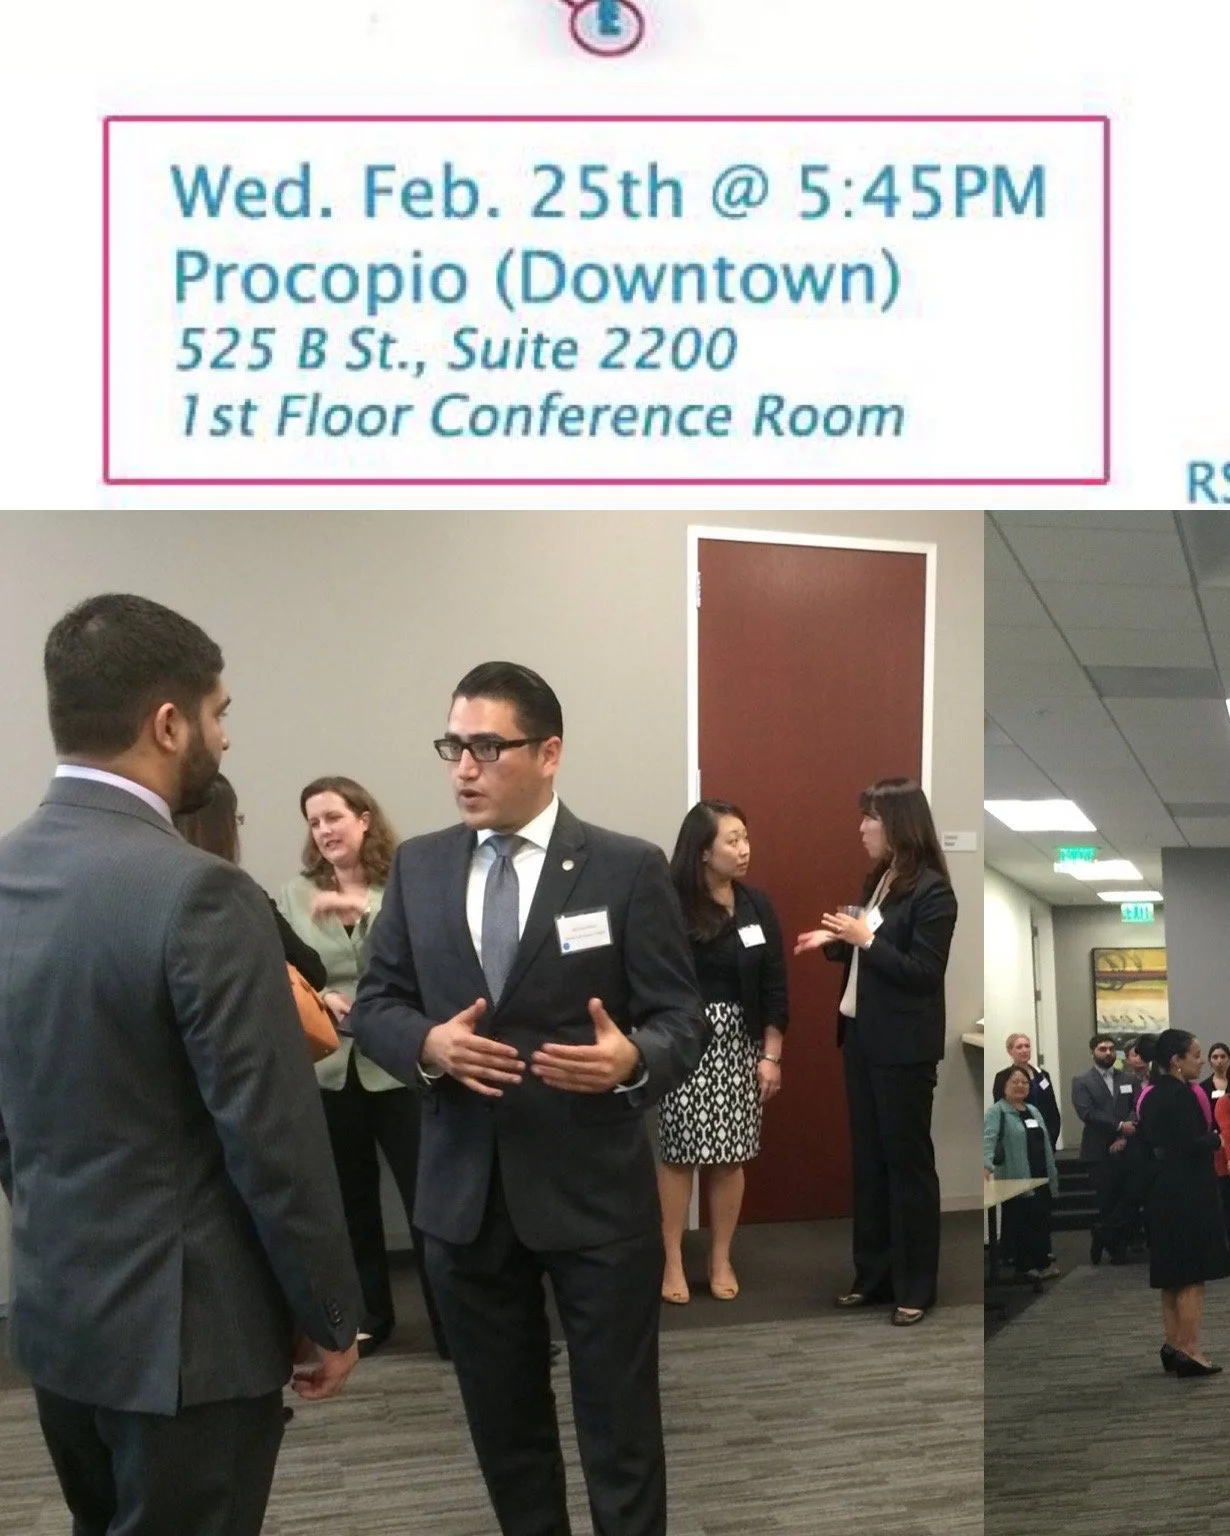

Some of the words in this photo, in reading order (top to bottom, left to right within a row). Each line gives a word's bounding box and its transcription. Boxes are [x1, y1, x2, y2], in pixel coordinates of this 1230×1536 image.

[170, 161, 332, 220] Wed.
[364, 161, 499, 220] Feb.
[530, 162, 683, 221] 25th
[712, 163, 769, 220] @
[801, 164, 1046, 221] 5:45PM
[175, 249, 467, 317] Procopio
[495, 248, 900, 313] (Downtown)
[176, 326, 276, 372] 525
[298, 327, 329, 370] B
[345, 326, 425, 378] St.,
[448, 326, 578, 371] Suite
[599, 326, 738, 372] 2200
[185, 394, 258, 437] 1st
[277, 392, 414, 438] Floor
[430, 391, 732, 438] Conference
[753, 394, 905, 438] Room
